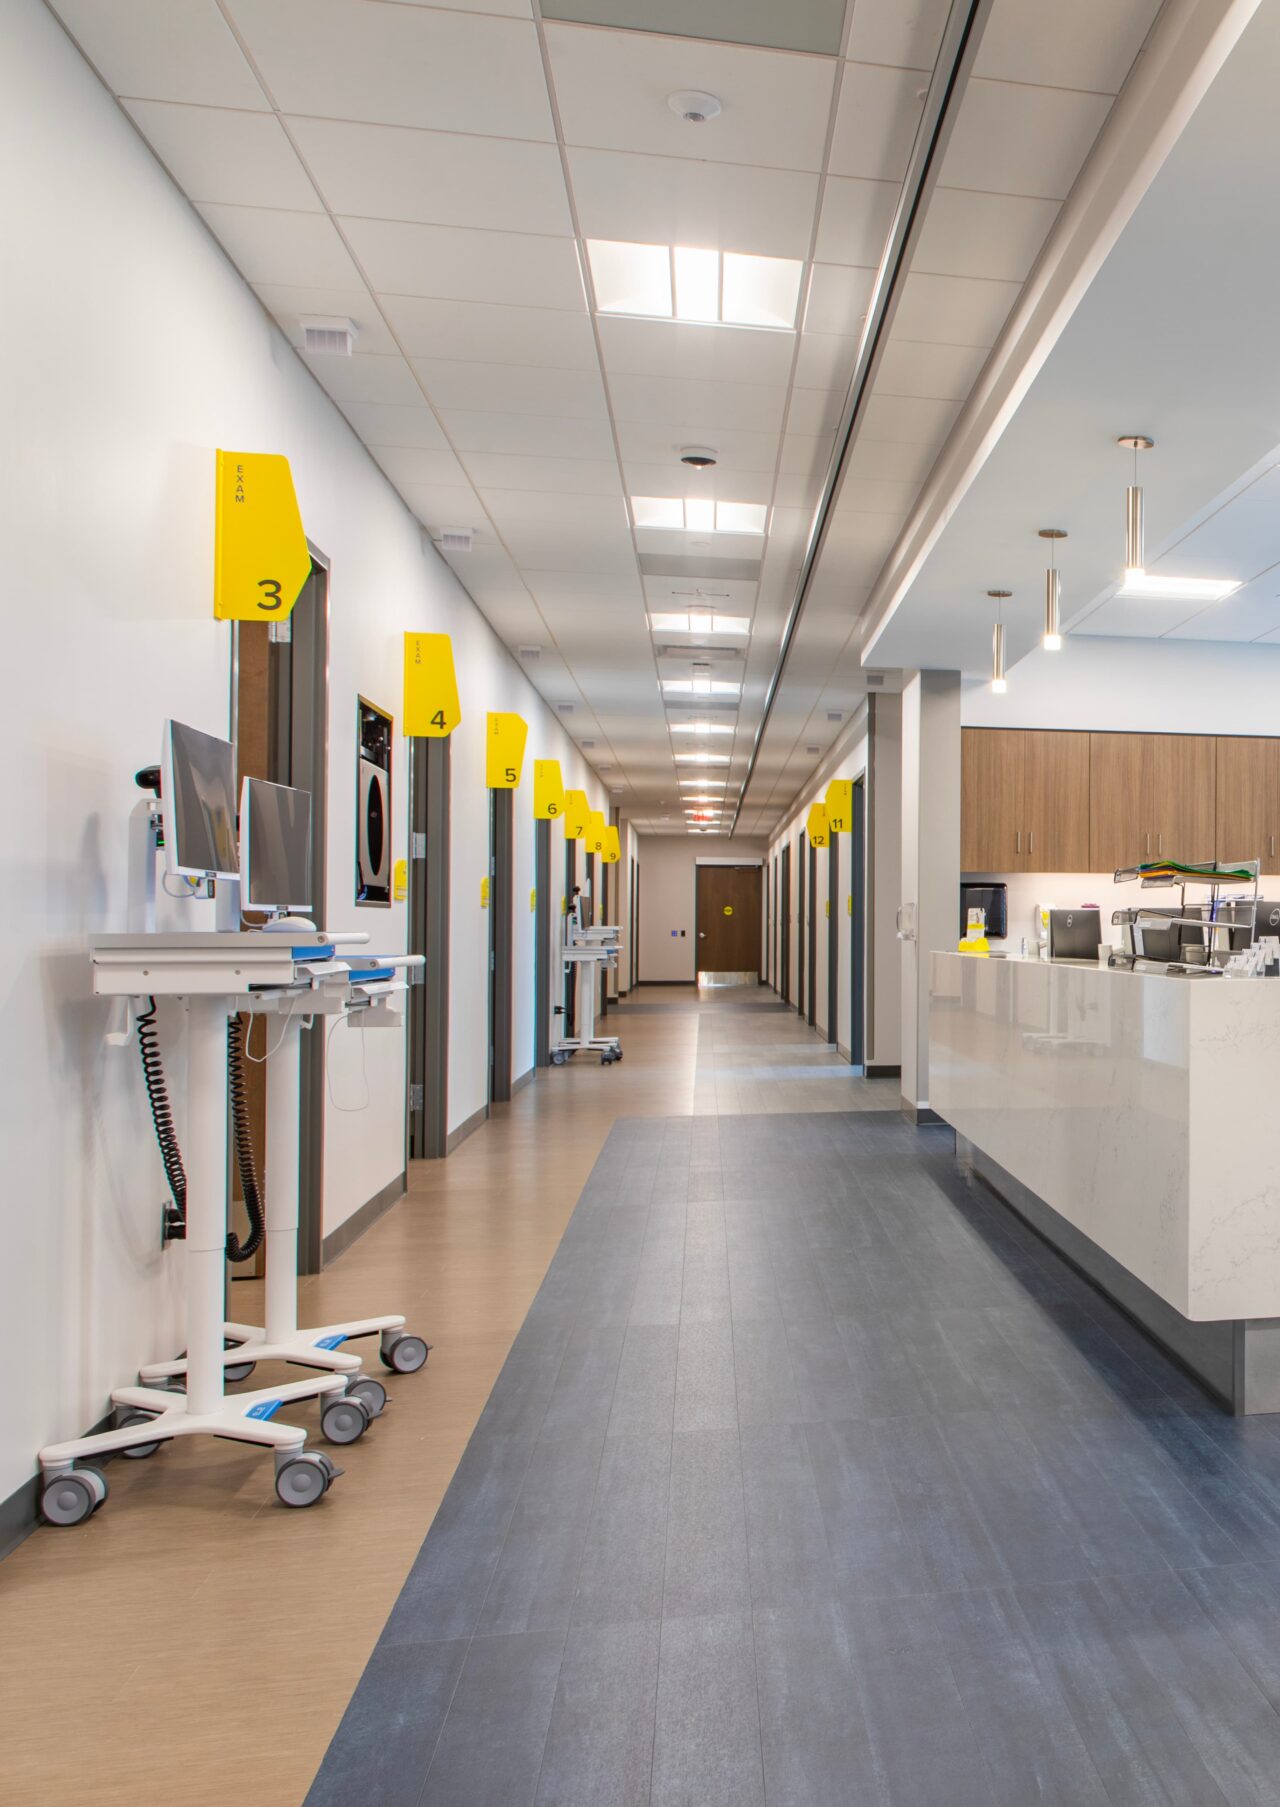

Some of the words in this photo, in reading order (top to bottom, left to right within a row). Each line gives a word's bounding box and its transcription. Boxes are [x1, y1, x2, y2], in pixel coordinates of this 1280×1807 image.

[235, 465, 245, 503] EXAM
[257, 579, 282, 611] 3
[430, 709, 447, 730] 4
[505, 768, 517, 783] 5
[547, 803, 558, 815] 6
[832, 818, 843, 829] 11
[576, 826, 583, 836] 7
[812, 835, 825, 845] 12
[595, 842, 602, 851] 8
[610, 852, 617, 860] 9
